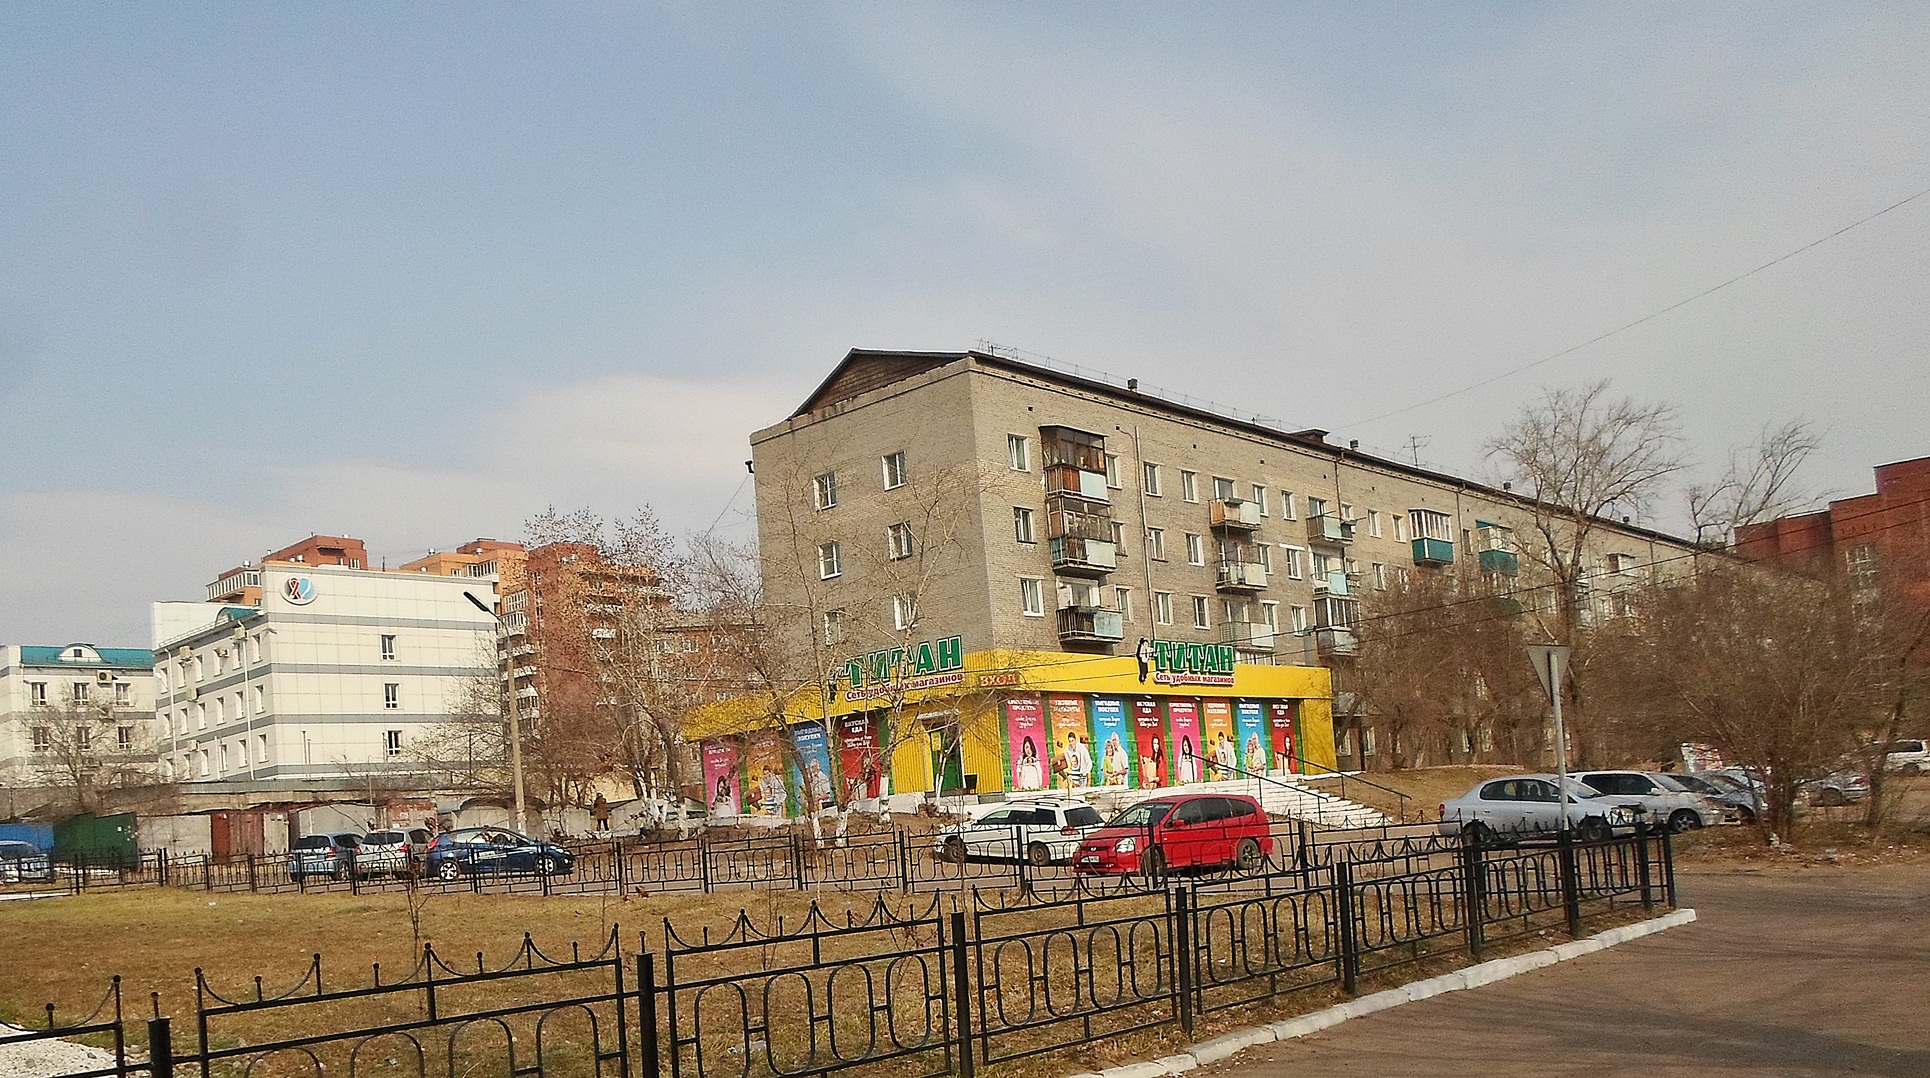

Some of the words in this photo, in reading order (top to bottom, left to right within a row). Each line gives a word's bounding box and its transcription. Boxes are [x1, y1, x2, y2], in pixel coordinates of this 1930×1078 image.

[844, 634, 963, 688] ТИТАН
[1153, 640, 1234, 673] ТИТАН
[846, 690, 866, 700] Сеть
[911, 673, 963, 688] магазинов
[1155, 672, 1171, 681] Сеть
[1172, 674, 1201, 683] удобных
[1202, 676, 1235, 684] магазинов
